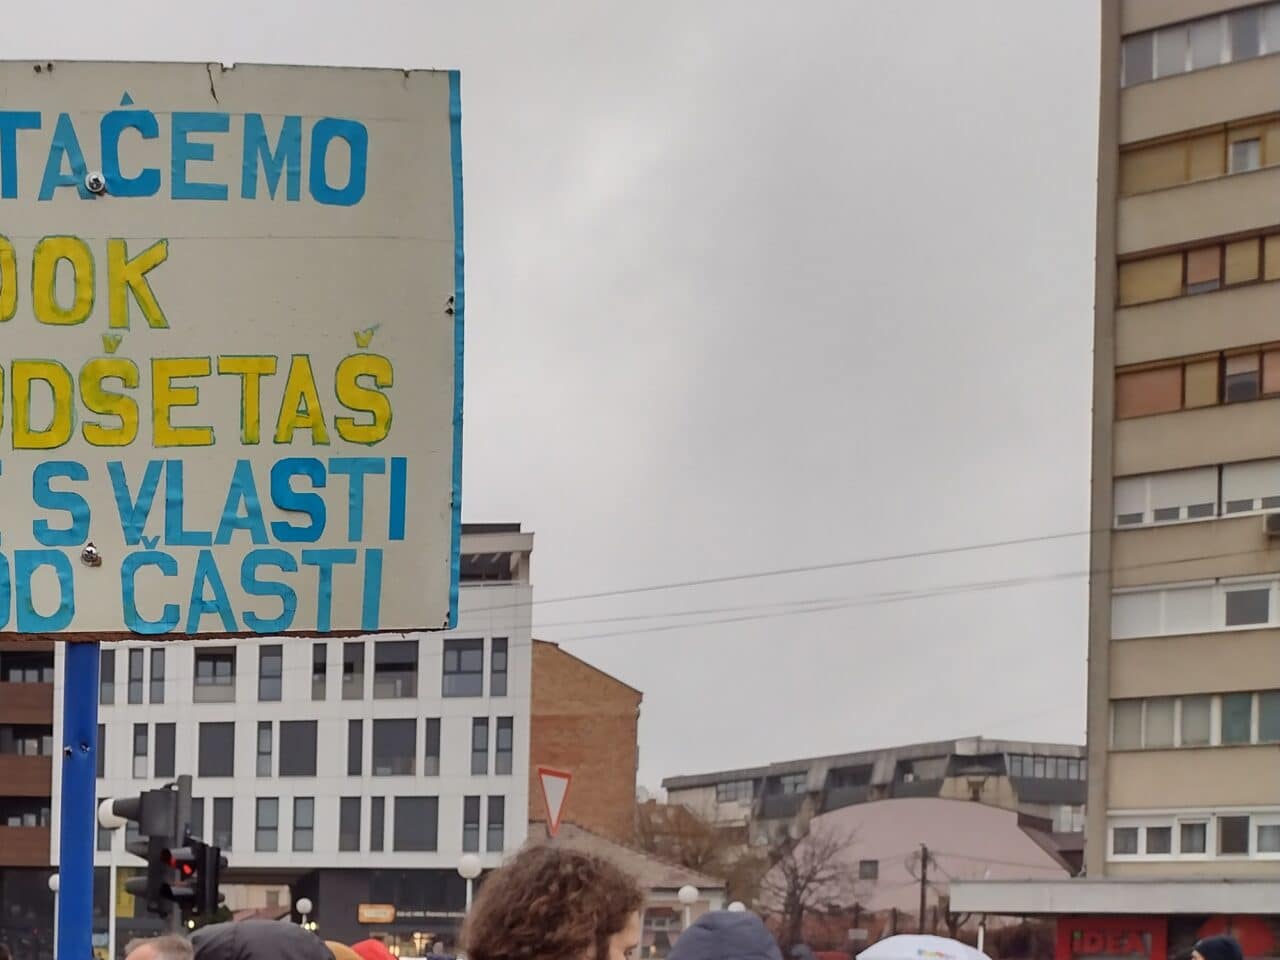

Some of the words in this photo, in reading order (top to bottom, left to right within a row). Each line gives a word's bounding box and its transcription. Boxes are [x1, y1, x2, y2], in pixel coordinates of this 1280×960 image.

[33, 460, 91, 547] S
[108, 457, 408, 546] VLASTI
[120, 535, 383, 635] ČASTI
